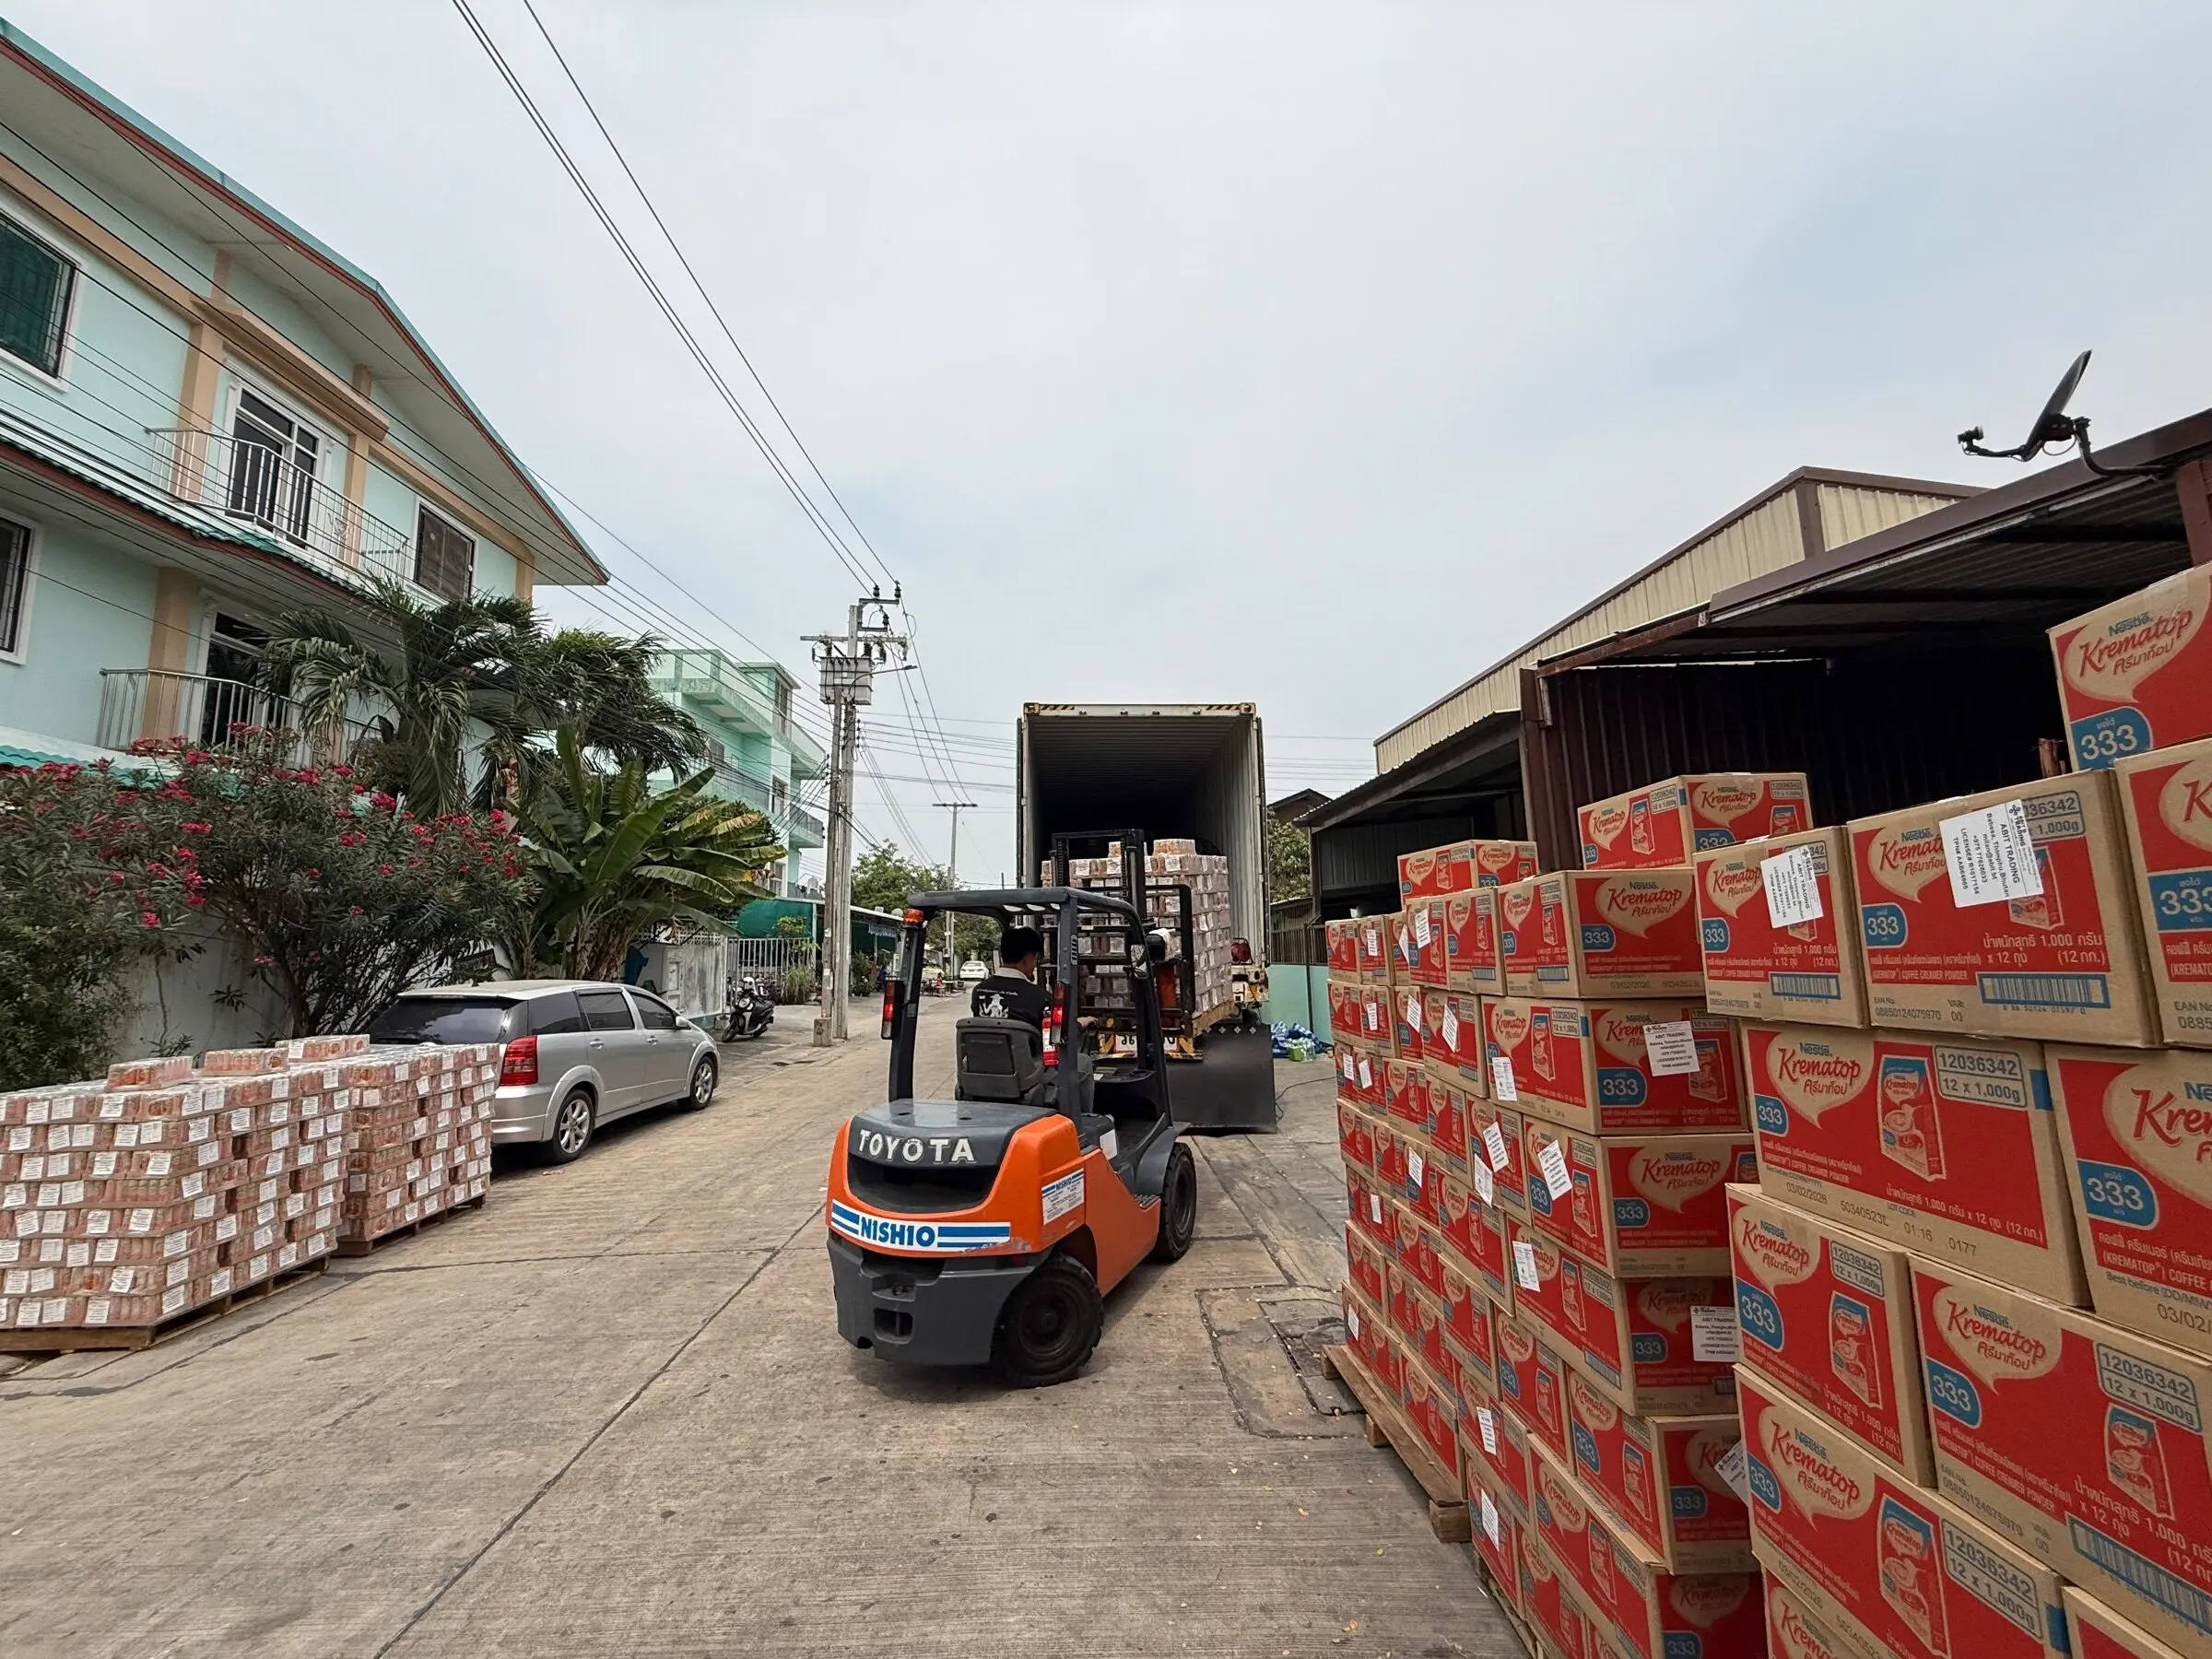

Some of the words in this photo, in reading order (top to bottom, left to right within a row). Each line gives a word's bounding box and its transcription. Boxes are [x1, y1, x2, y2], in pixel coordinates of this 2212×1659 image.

[2080, 608, 2193, 677] Krematop
[2113, 639, 2174, 676] ครีมาท็อป
[2081, 724, 2137, 760] 333
[1701, 790, 1757, 808] Krematop
[1593, 811, 1626, 834] Krematop
[2000, 823, 2011, 843] ABIT
[2004, 843, 2020, 884] TRADING
[1712, 866, 1761, 893] Krematop
[1608, 888, 1682, 912] Krematop
[1799, 877, 1810, 909] TRADING
[1704, 928, 1725, 942] 333
[1867, 916, 1899, 936] 333
[1585, 932, 1609, 944] 333
[1983, 935, 2035, 952] น้ำหนักสุทธิ
[2077, 934, 2103, 947] กรัม
[1780, 958, 1788, 966] 12
[1987, 955, 1994, 963] x
[1996, 952, 2009, 963] 12
[2013, 951, 2028, 966] ถุง
[2058, 953, 2077, 965] (12
[2081, 952, 2105, 965] กก.)
[1945, 971, 1968, 981] POWDER
[1951, 1012, 1962, 1021] 00
[2174, 1001, 2195, 1012] EAN
[1778, 1048, 1861, 1086] Krematop
[1939, 1053, 2018, 1076] 12036342
[1603, 1079, 1638, 1096] 333
[1803, 1079, 1848, 1095] ครีมาท็อป
[1943, 1077, 1959, 1090] 12
[1963, 1082, 1971, 1093] x
[1974, 1081, 2020, 1102] 1,000g
[1758, 1106, 1783, 1125] 333
[858, 1129, 977, 1164] TOYOTA
[1641, 1158, 1721, 1183] Krematop
[1531, 1184, 1548, 1206] 333
[2087, 1177, 2144, 1210] 333
[1617, 1207, 1644, 1219] 333
[1974, 1211, 1988, 1225] 12
[2006, 1219, 2022, 1236] (12
[860, 1217, 935, 1247] NISHIO
[1903, 1221, 1934, 1241] 01:16
[1742, 1218, 1809, 1272] Krematop
[1948, 1237, 1977, 1255] 0177
[1832, 1245, 1879, 1277] 12036342
[1834, 1264, 1845, 1276] 12
[2169, 1266, 2206, 1290] COFFEE
[1741, 1294, 1775, 1334] 333
[1947, 1300, 2046, 1365] Krematop
[1635, 1342, 1661, 1355] 333
[2101, 1350, 2191, 1400] 12036342
[1932, 1374, 1971, 1413] 333
[2105, 1376, 2122, 1392] 12
[2128, 1386, 2137, 1398] x
[1833, 1403, 1843, 1419] 12
[1576, 1434, 1596, 1464] 333
[1771, 1418, 1860, 1510] Krematop
[1751, 1465, 1775, 1499] 333
[1675, 1497, 1701, 1510] 333
[2080, 1500, 2088, 1513] x
[2092, 1506, 2108, 1525] 12
[1946, 1529, 2031, 1599] 12036342
[1950, 1555, 1964, 1575] 12
[1667, 1641, 1696, 1655] 333
